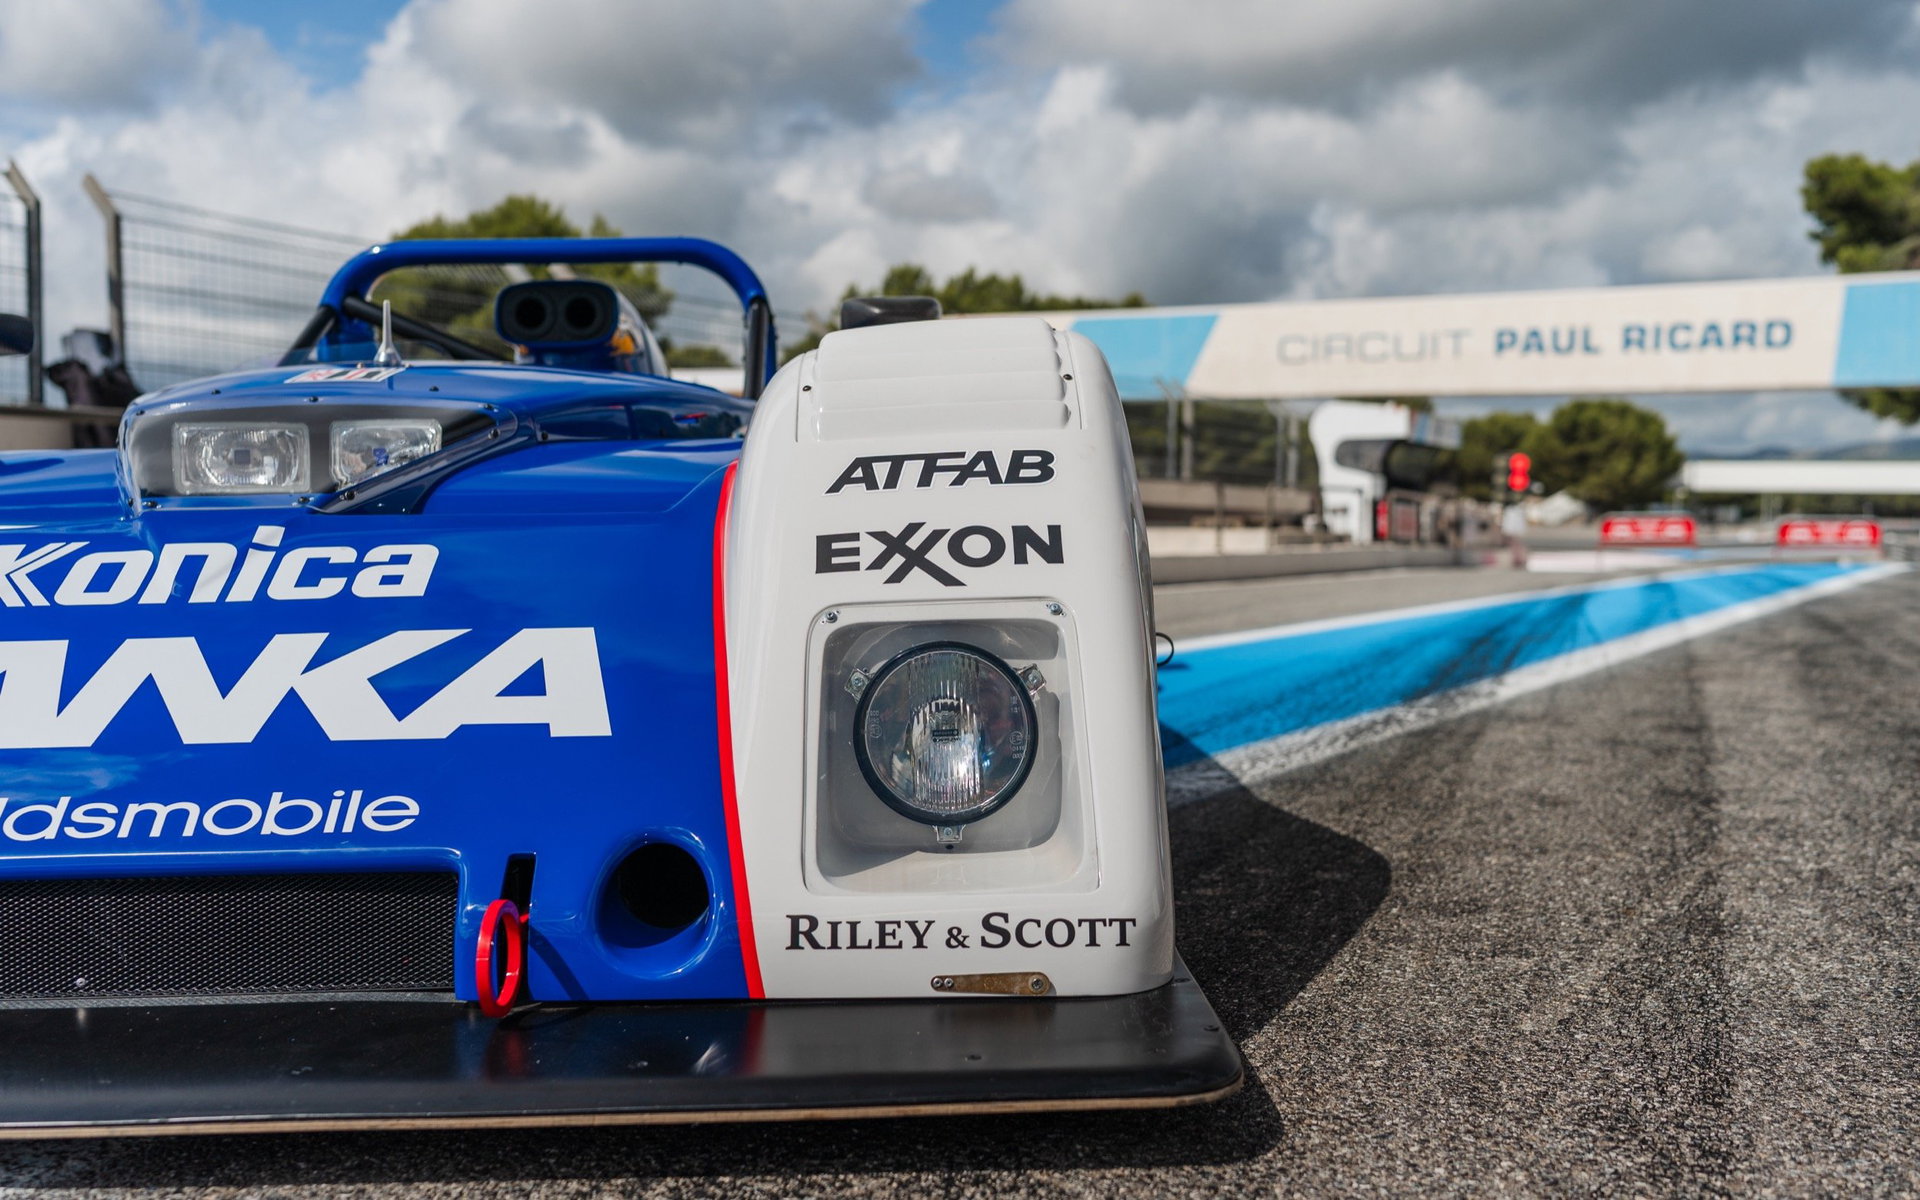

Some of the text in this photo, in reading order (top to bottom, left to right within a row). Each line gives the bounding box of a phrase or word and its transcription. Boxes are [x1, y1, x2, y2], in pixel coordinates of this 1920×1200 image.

[1277, 319, 1794, 365] CIRCUIT PAUL RICARD
[825, 448, 1056, 495] ATFAB
[0, 525, 440, 607] Konica
[815, 522, 1065, 587] EXXON
[0, 789, 420, 842] dsmobile
[785, 911, 1137, 951] RILEY & SCOTT
